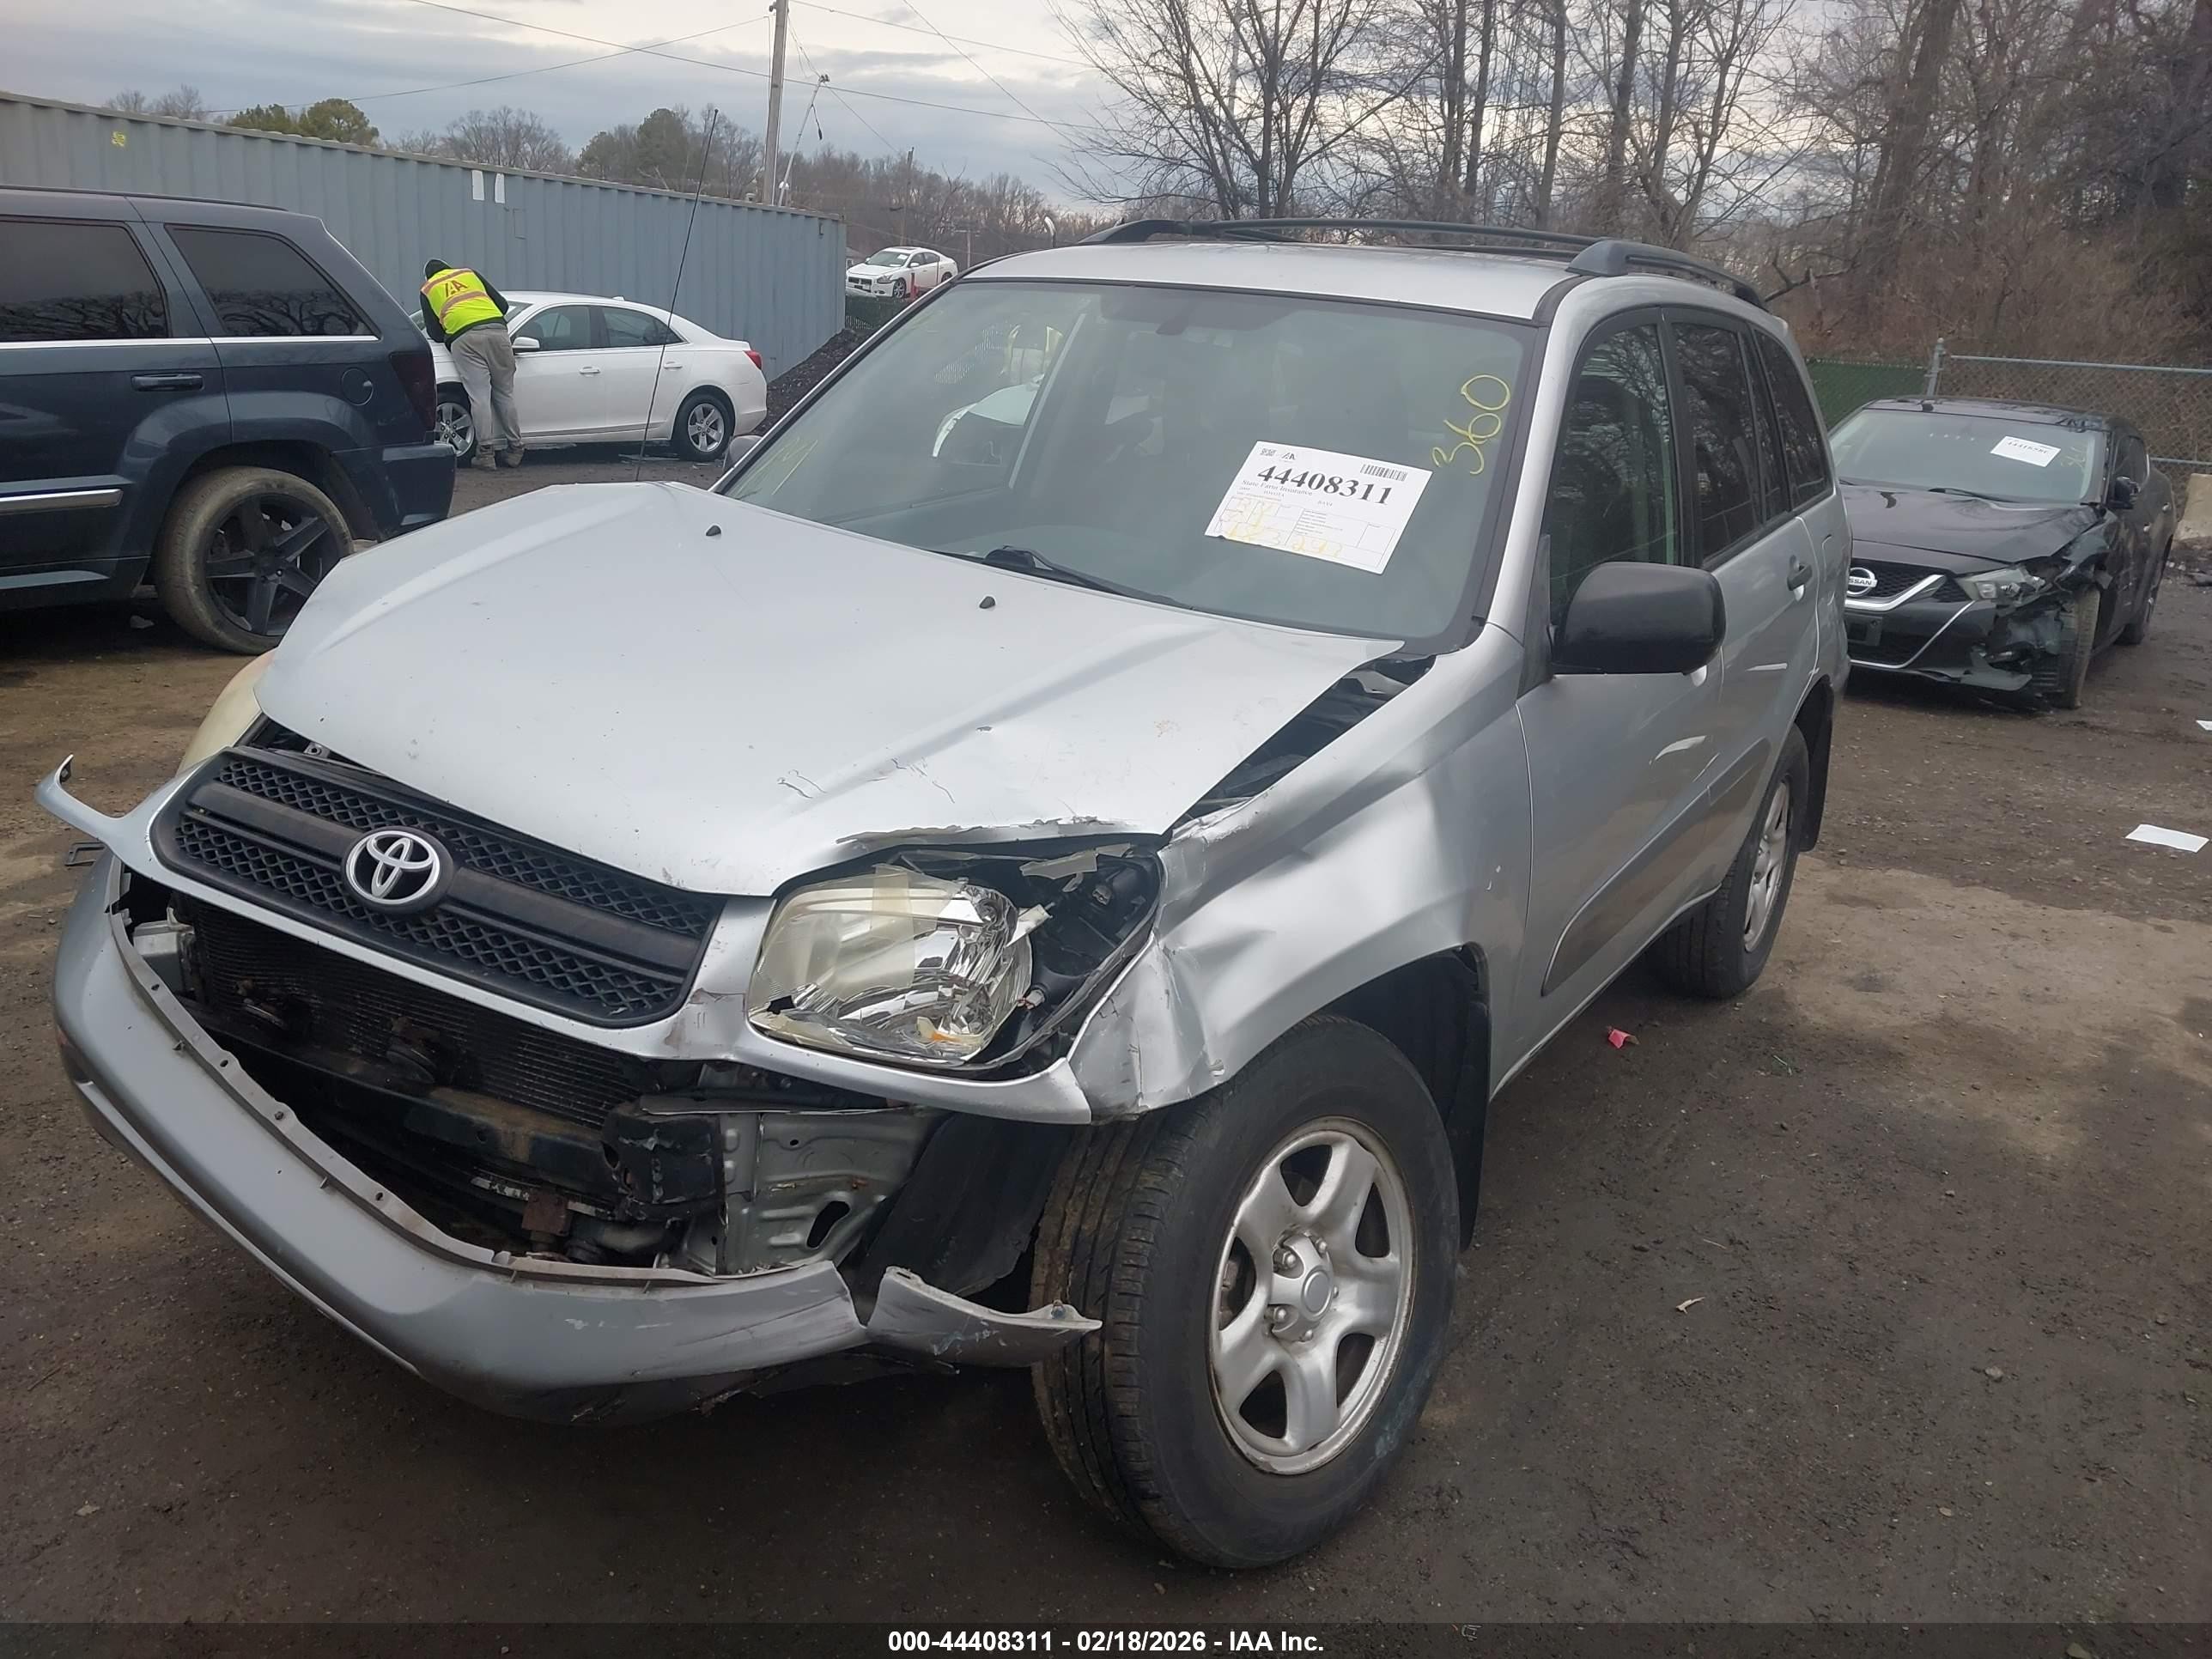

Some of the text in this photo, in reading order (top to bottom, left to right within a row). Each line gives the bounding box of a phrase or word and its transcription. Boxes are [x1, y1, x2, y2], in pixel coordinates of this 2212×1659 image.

[1431, 374, 1511, 475] 360
[1257, 465, 1394, 505] 44408311
[1279, 485, 1312, 495] Insurance
